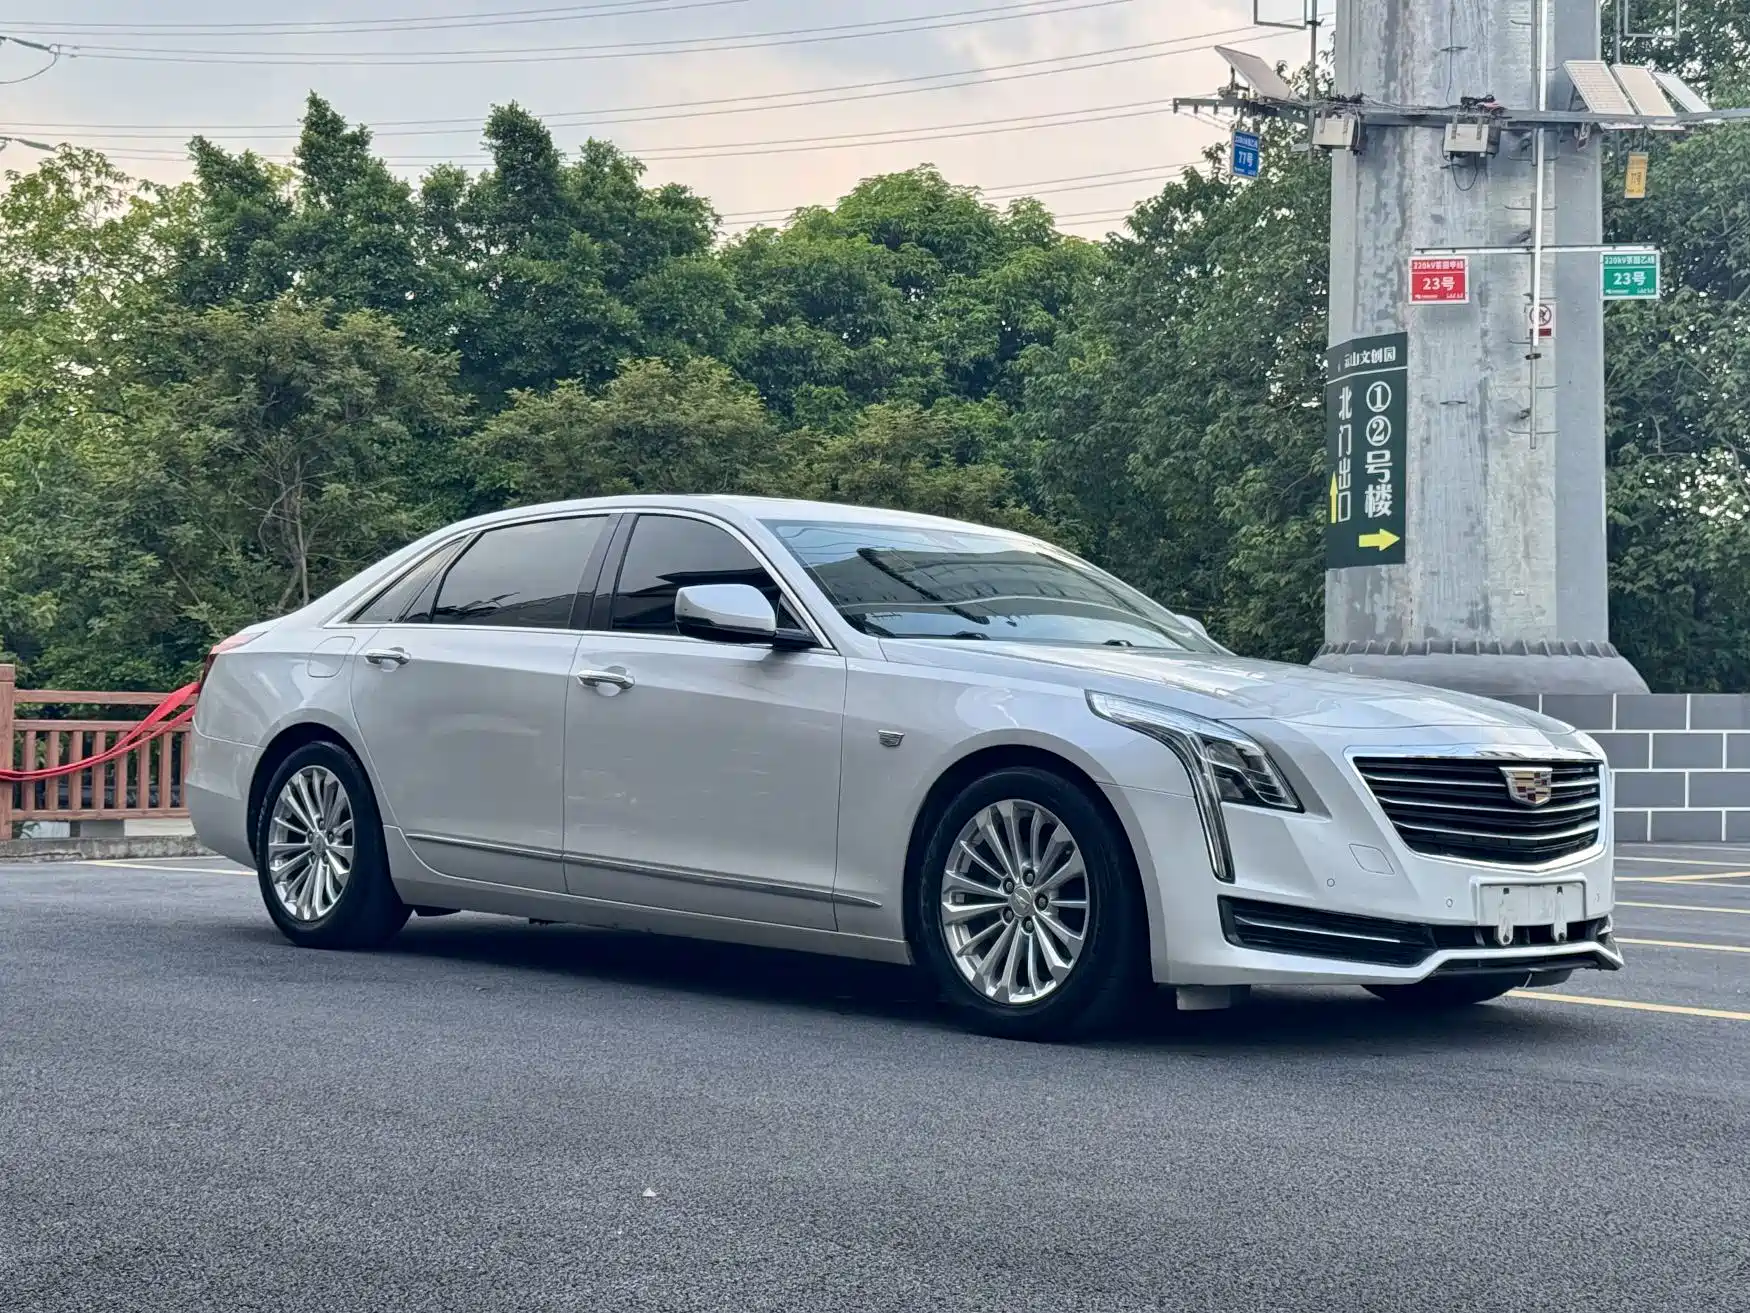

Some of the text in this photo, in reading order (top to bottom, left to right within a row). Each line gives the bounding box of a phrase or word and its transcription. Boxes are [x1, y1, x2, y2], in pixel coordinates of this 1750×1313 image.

[1422, 276, 1455, 291] 23号
[1613, 271, 1646, 286] 23号
[1338, 386, 1353, 523] 北门出口
